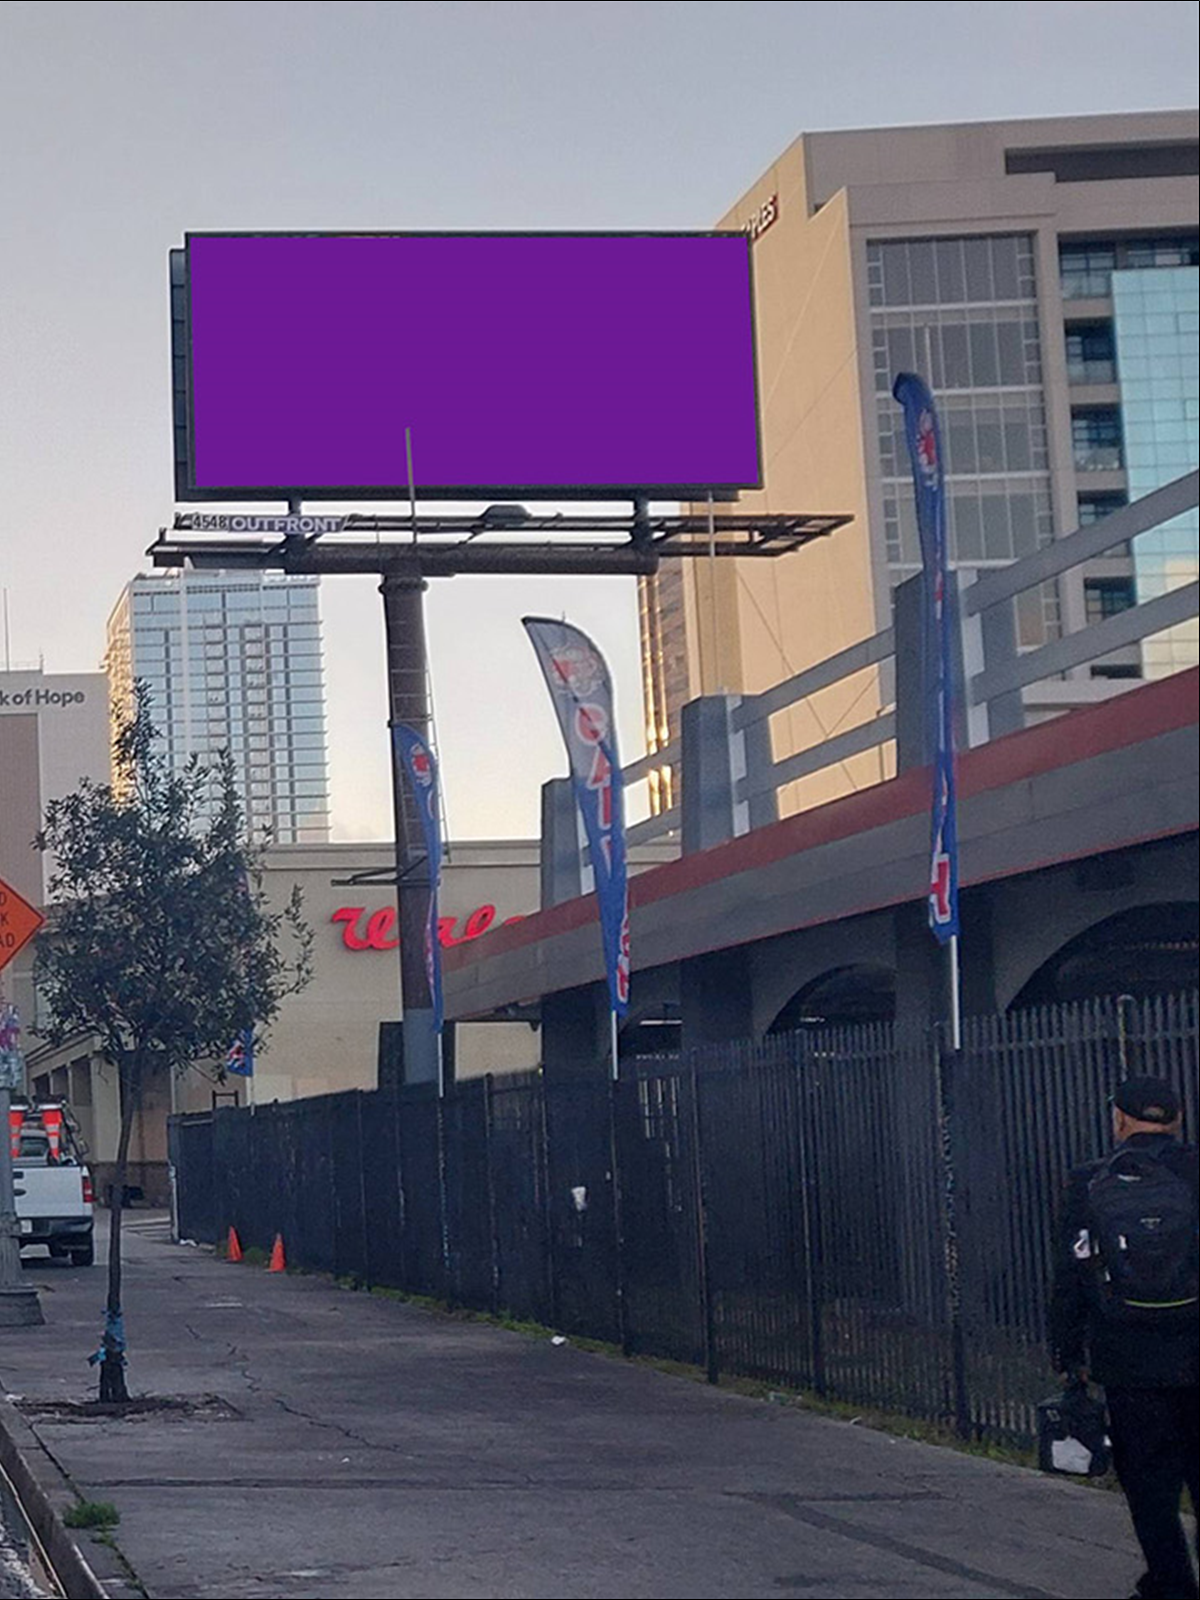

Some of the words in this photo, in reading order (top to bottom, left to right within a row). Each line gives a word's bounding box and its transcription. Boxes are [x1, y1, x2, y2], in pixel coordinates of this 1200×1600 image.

[231, 516, 341, 532] OUTFRONT
[12, 688, 33, 706] of
[35, 688, 85, 708] Hope
